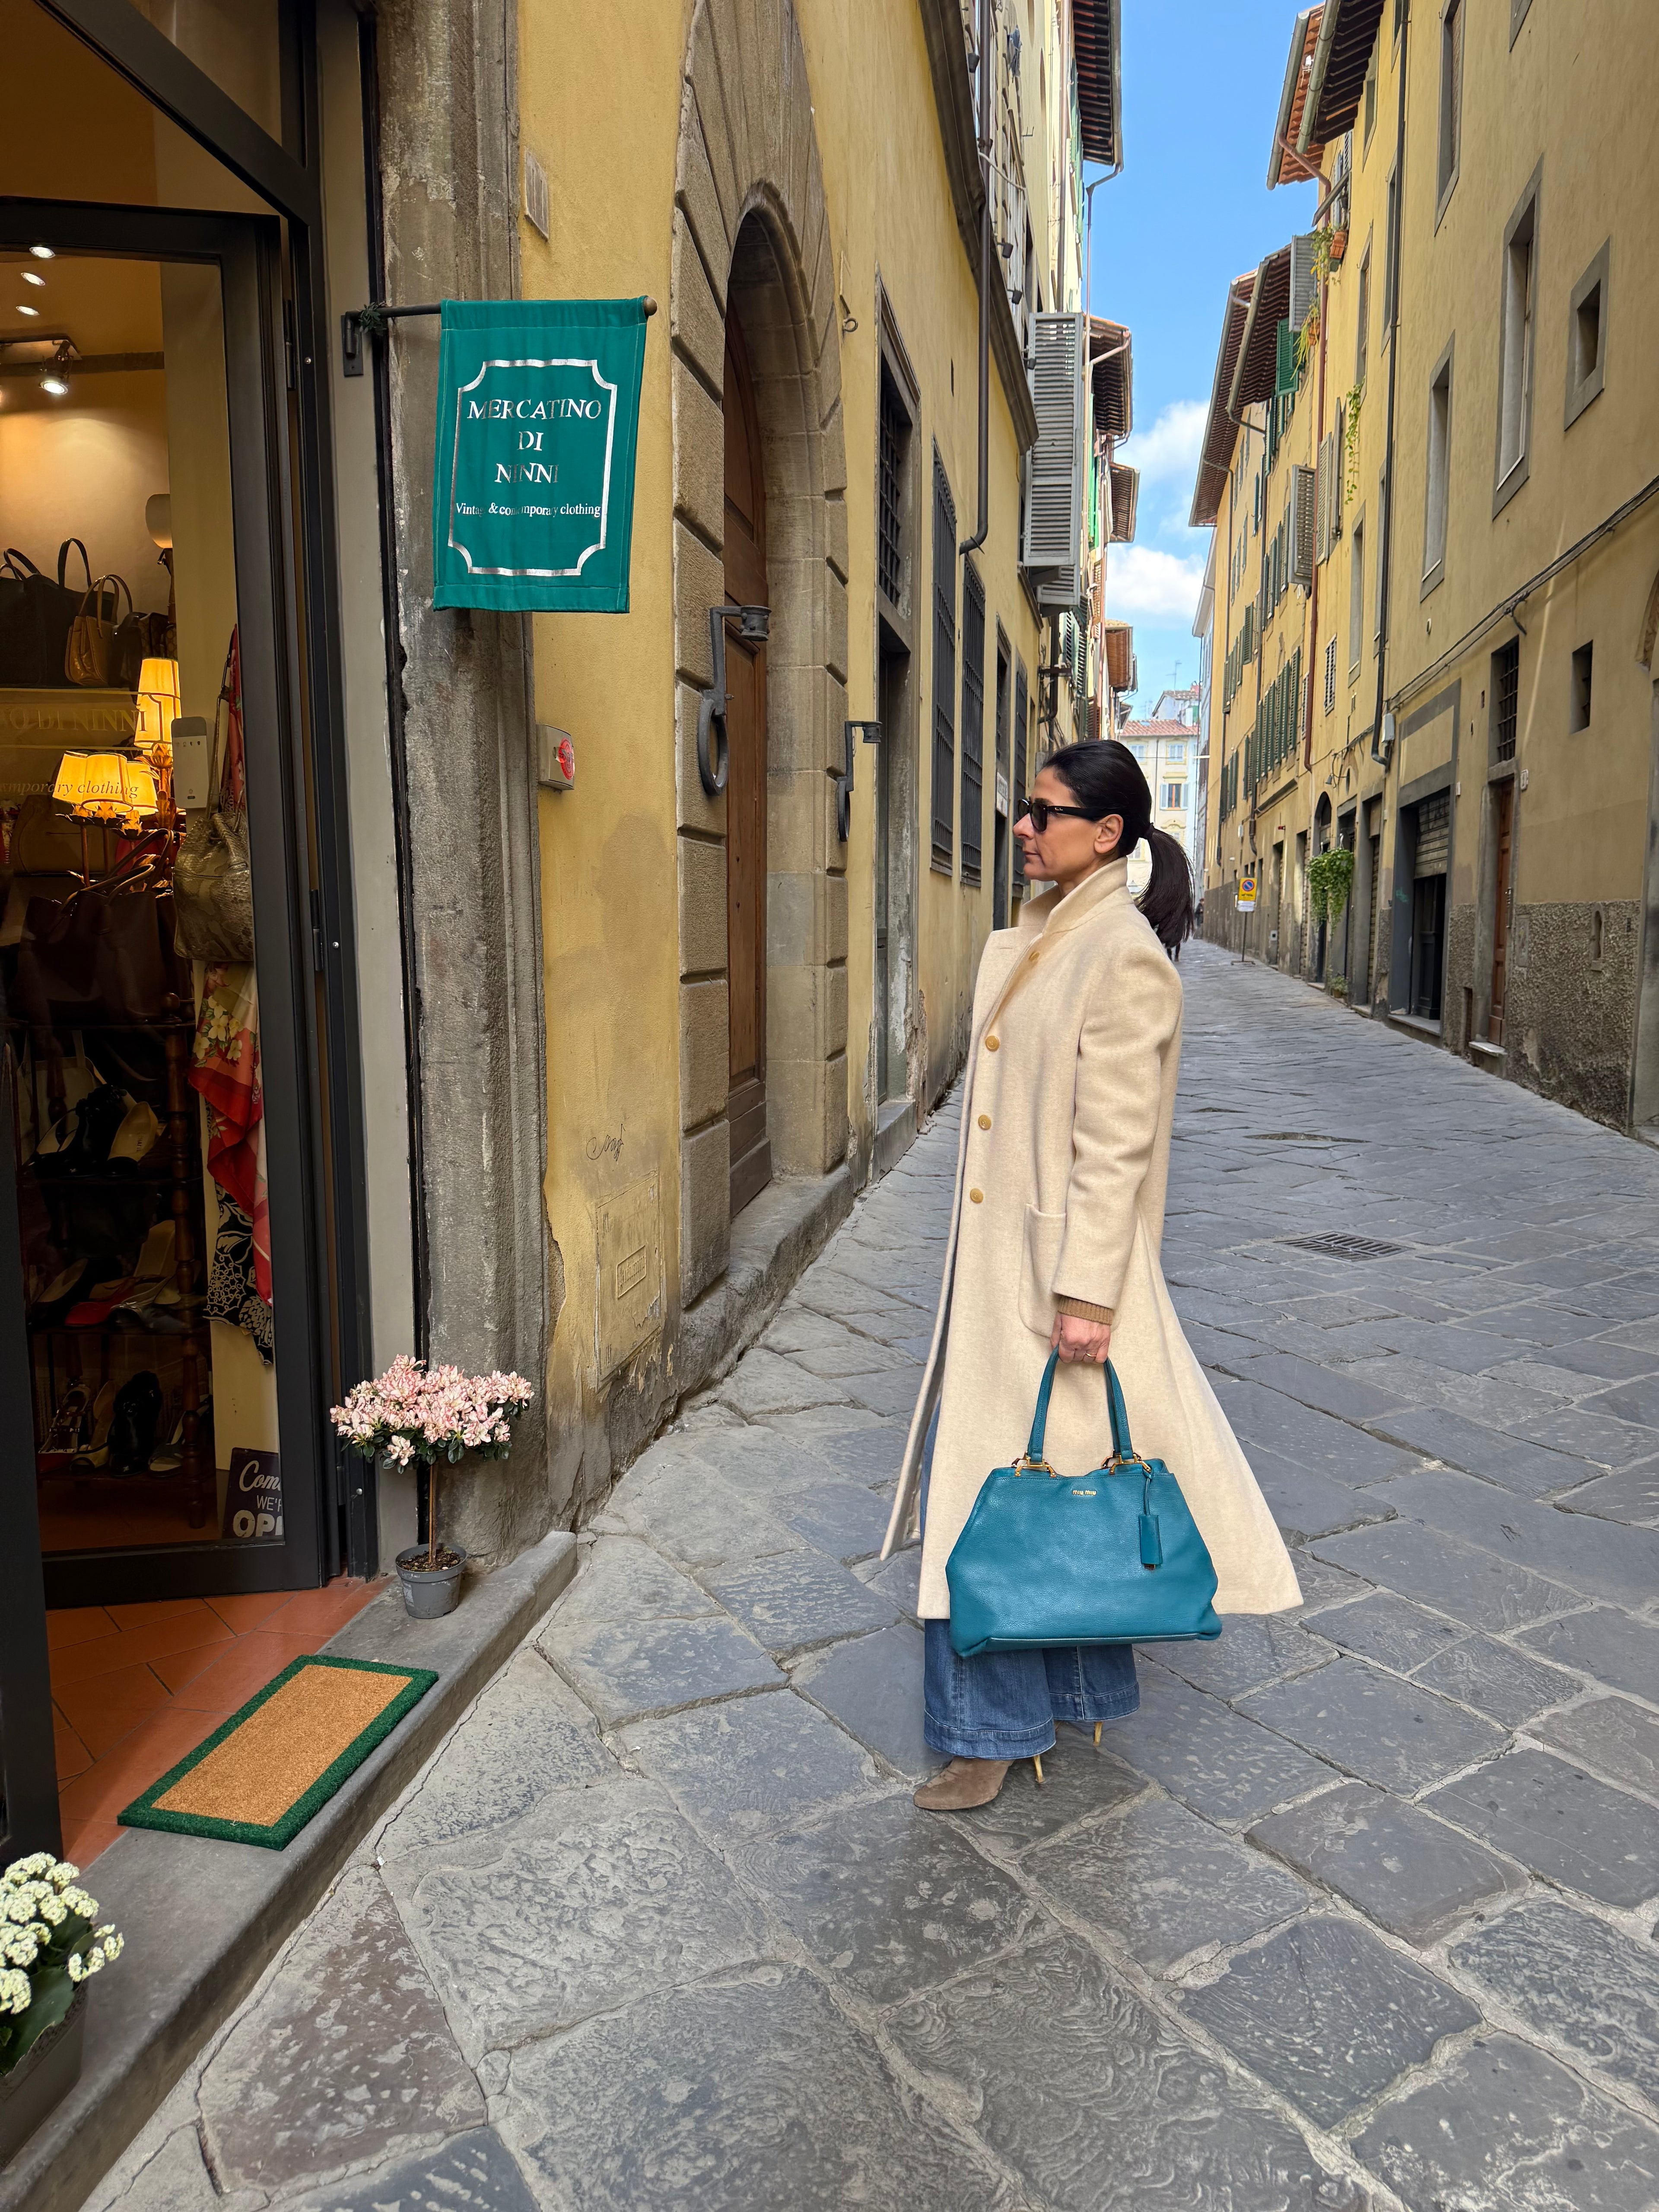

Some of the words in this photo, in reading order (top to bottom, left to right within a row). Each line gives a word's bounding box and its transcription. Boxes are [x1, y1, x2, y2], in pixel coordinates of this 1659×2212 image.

[467, 398, 602, 420] MERCATINO
[517, 431, 544, 451] DI
[494, 462, 559, 483] NINNI
[560, 502, 602, 518] clothing
[78, 780, 139, 799] clothing
[239, 1460, 281, 1492] Com
